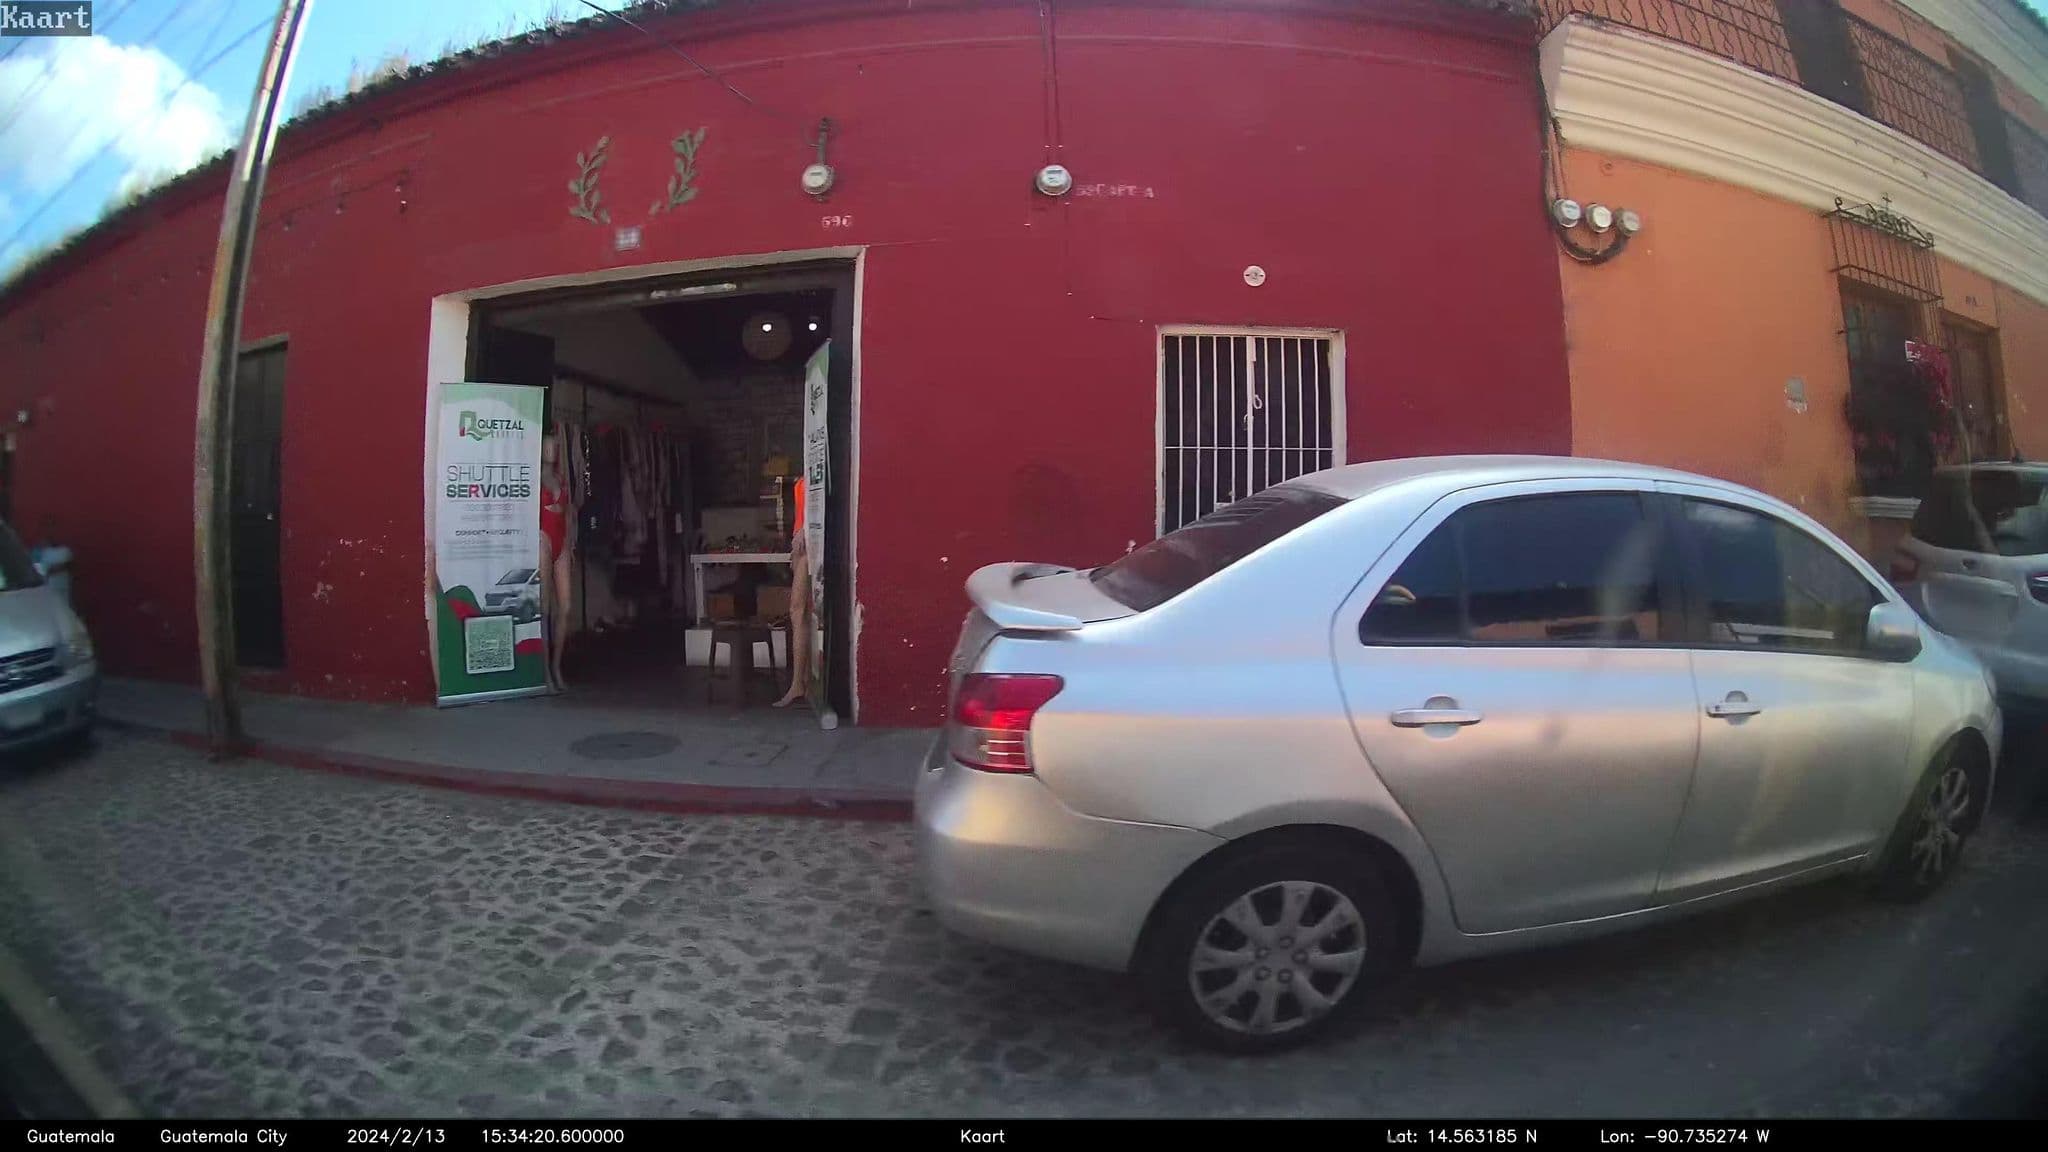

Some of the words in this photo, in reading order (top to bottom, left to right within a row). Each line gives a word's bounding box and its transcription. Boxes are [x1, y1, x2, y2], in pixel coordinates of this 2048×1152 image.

[477, 419, 525, 431] QUETZAL
[447, 465, 531, 482] SHUTTLE
[446, 484, 531, 498] SERVICES
